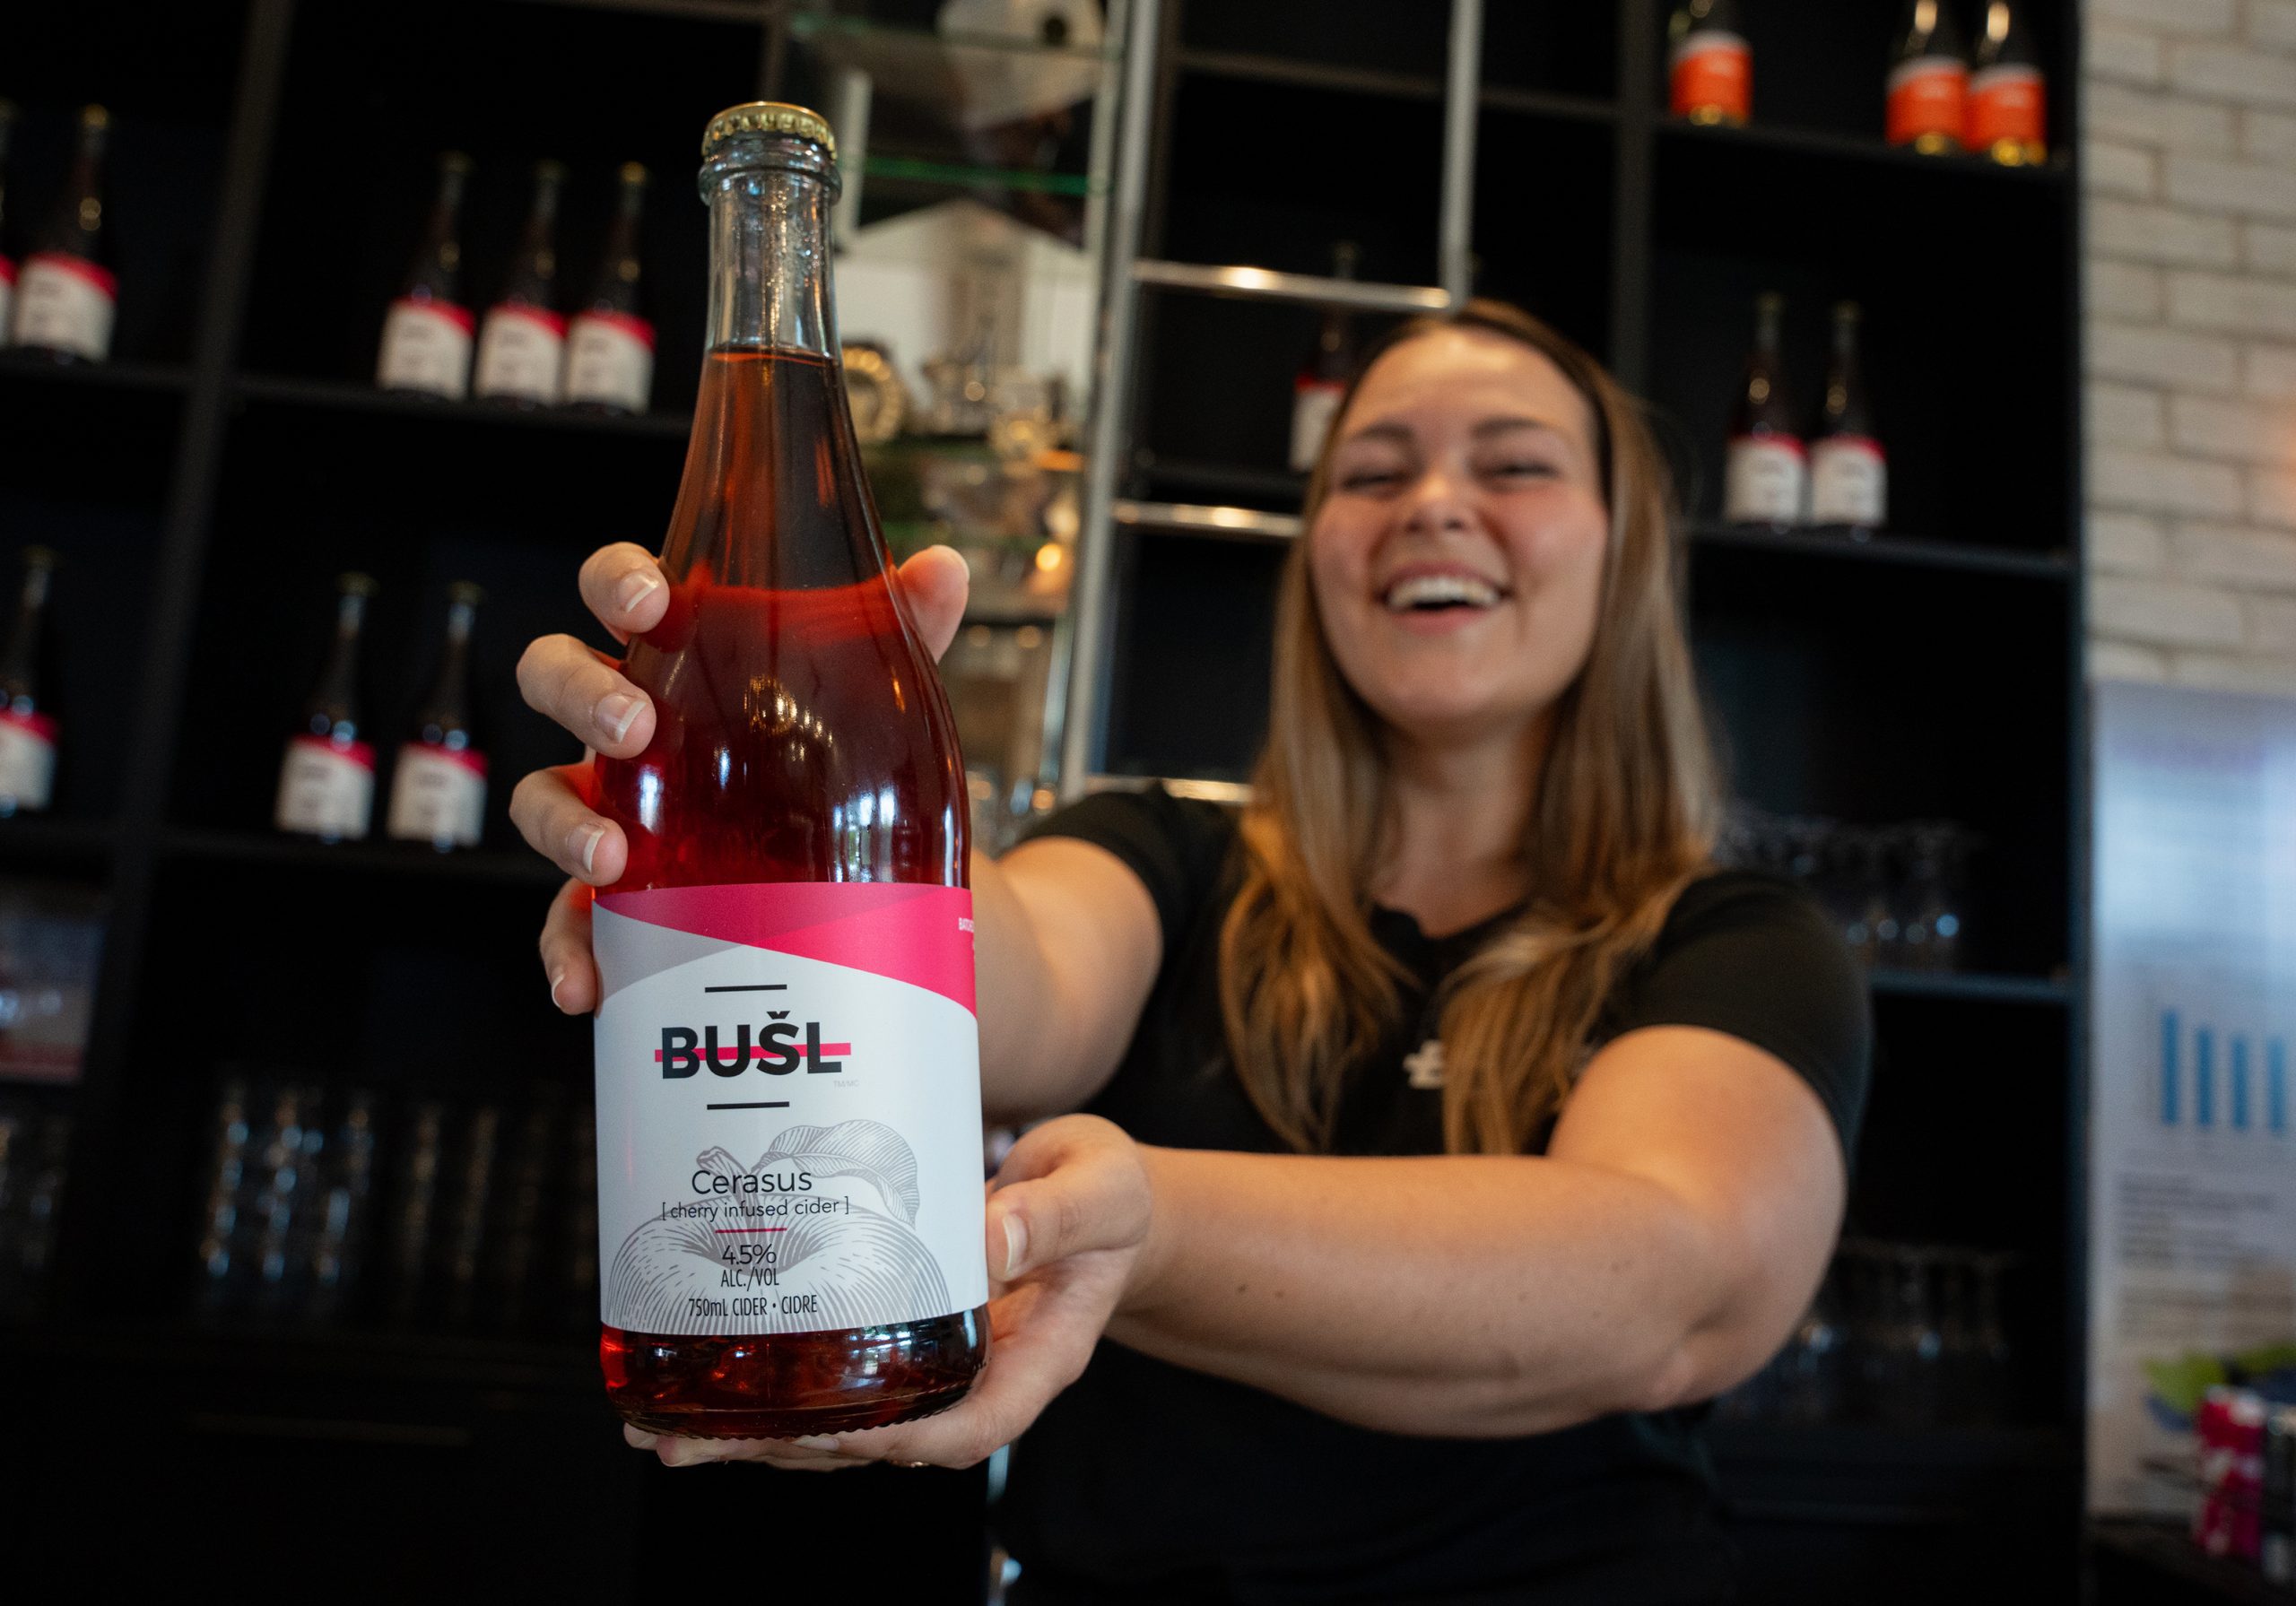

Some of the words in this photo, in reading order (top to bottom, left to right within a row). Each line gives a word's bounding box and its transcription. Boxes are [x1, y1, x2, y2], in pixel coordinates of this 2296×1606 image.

[662, 1011, 842, 1080] BUŠL
[691, 1169, 813, 1194] Cerasus
[724, 1198, 788, 1218] infused
[722, 1244, 777, 1265] 4.5%
[720, 1266, 780, 1291] ALC./VOL
[732, 1298, 768, 1316] CIDER
[781, 1294, 818, 1314] CIDRE
